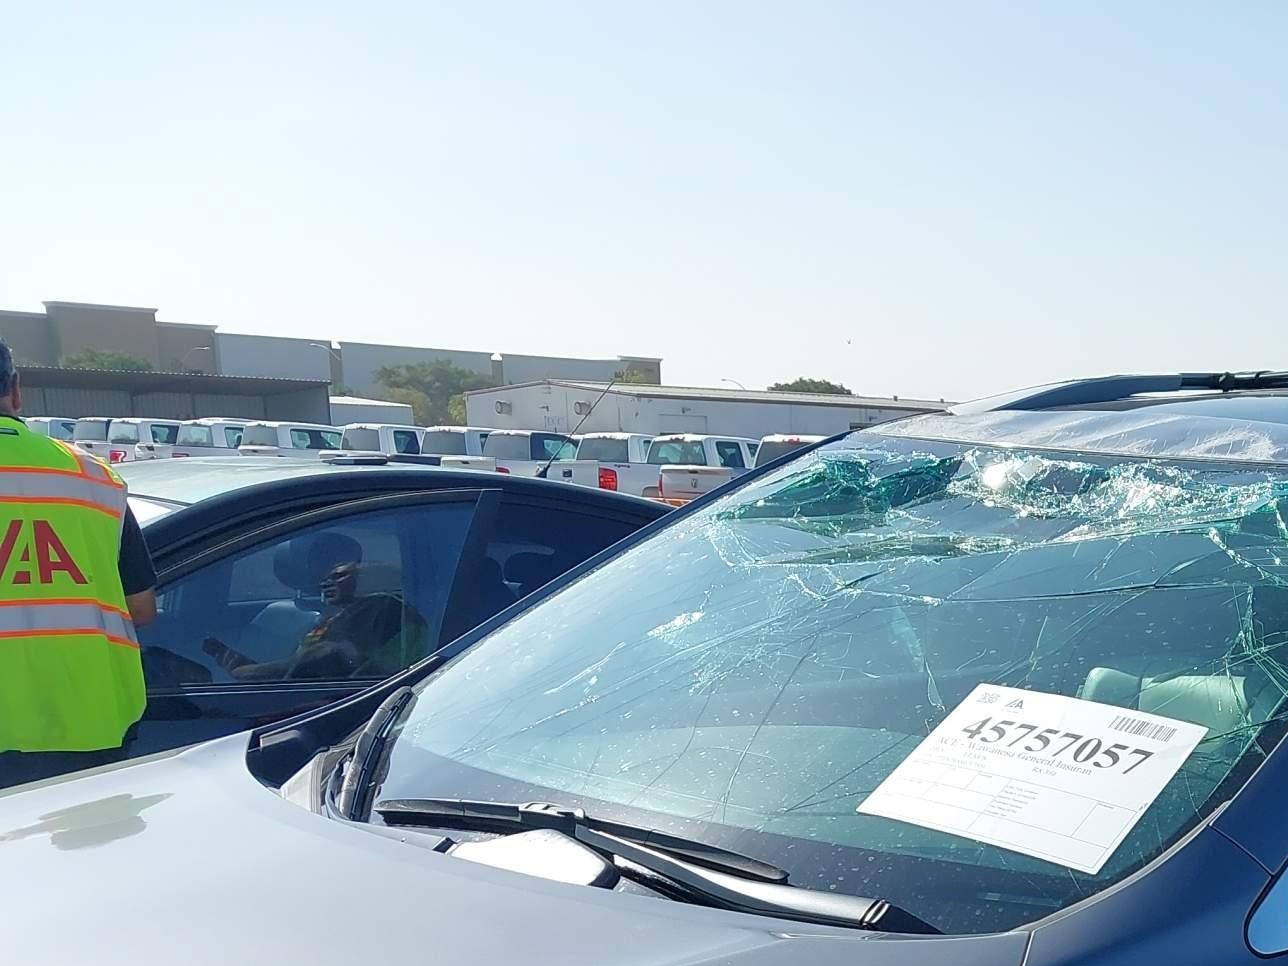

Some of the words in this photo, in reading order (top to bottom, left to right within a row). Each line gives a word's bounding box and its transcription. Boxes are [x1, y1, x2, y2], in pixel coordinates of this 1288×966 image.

[962, 717, 1154, 775] 45757057
[1017, 752, 1056, 767] General
[1055, 760, 1093, 776] Insuran
